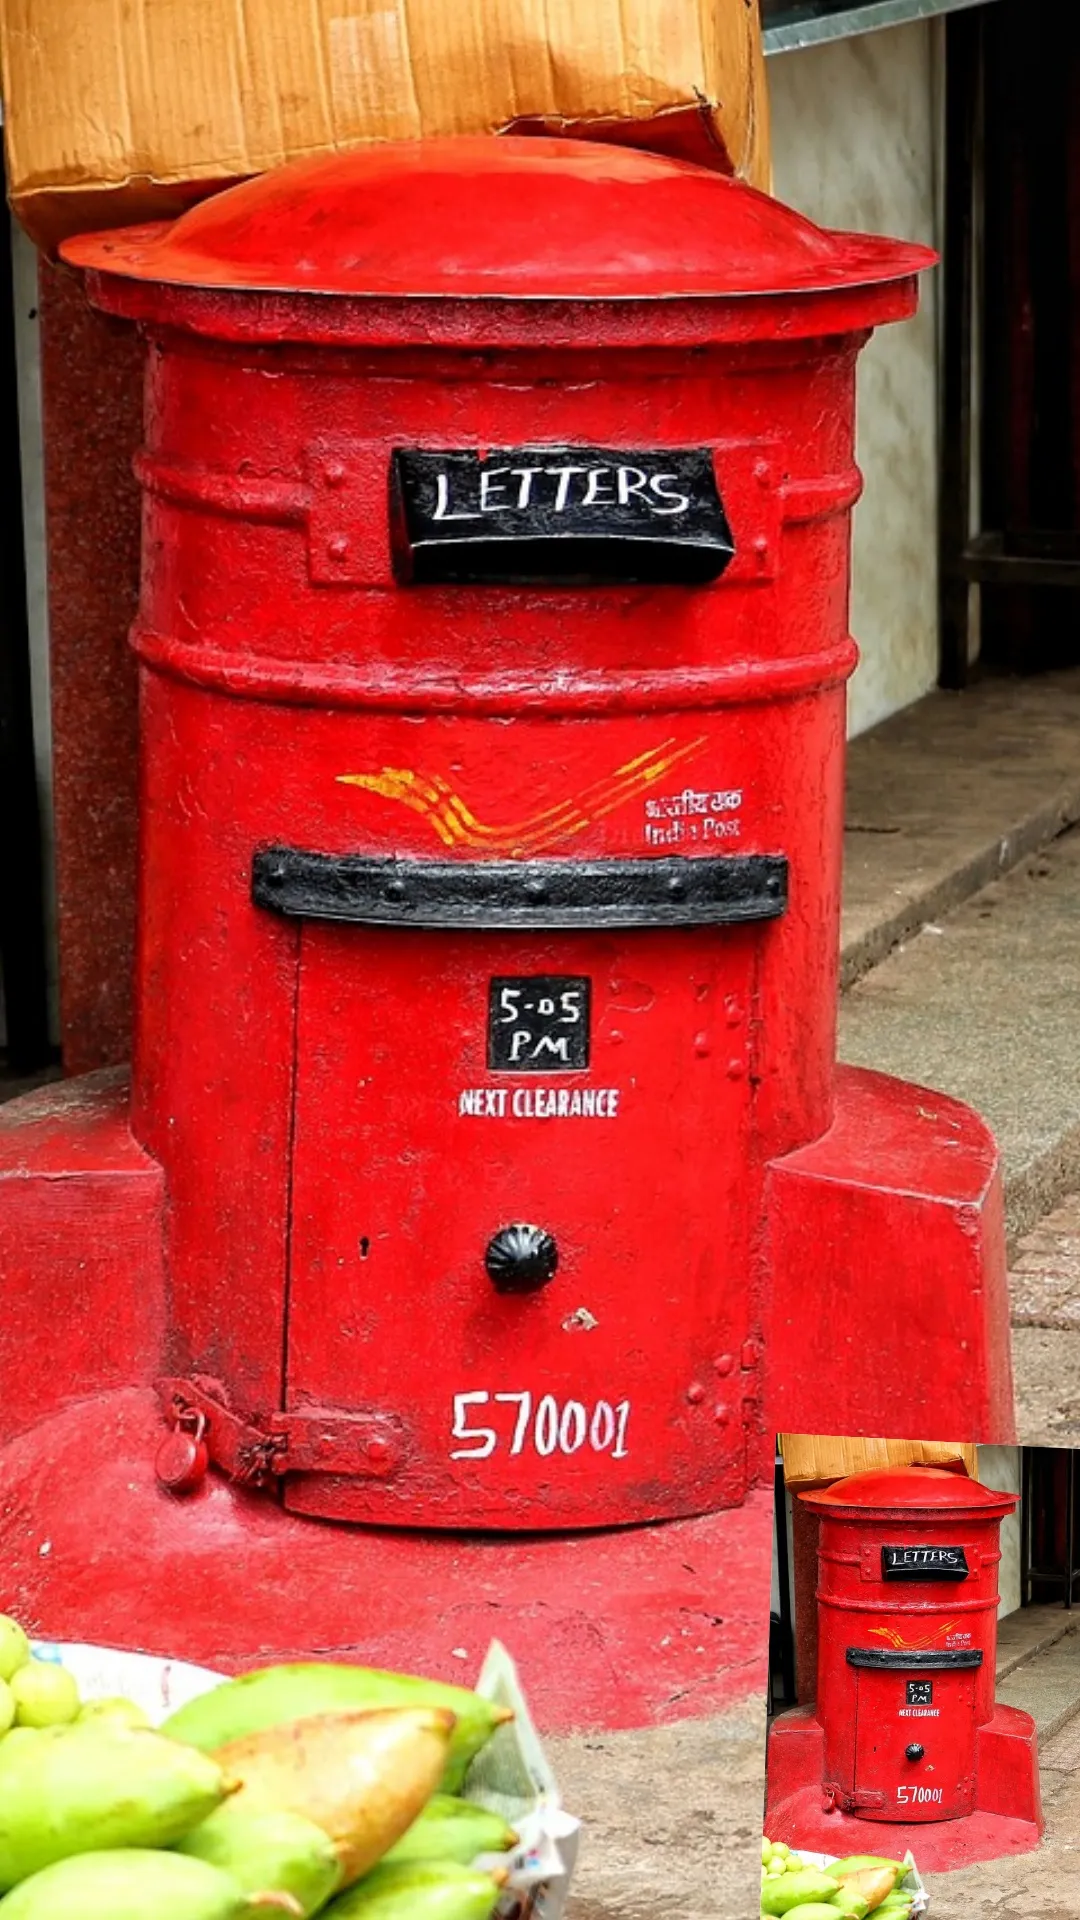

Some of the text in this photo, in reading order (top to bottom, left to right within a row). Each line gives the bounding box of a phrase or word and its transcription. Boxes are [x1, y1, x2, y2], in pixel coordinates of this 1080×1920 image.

[432, 466, 689, 520] LETTERS
[645, 821, 697, 845] Inda
[500, 987, 581, 1023] 5-05
[508, 1030, 571, 1061] PM
[458, 1089, 619, 1117] NEXT CLEARANCE
[449, 1391, 630, 1460] 570001
[892, 1550, 958, 1566] LETTERS
[909, 1683, 931, 1693] 5-05
[911, 1694, 927, 1703] PM
[899, 1708, 940, 1717] NEXT CLEARANCE
[896, 1785, 943, 1804] 570001
